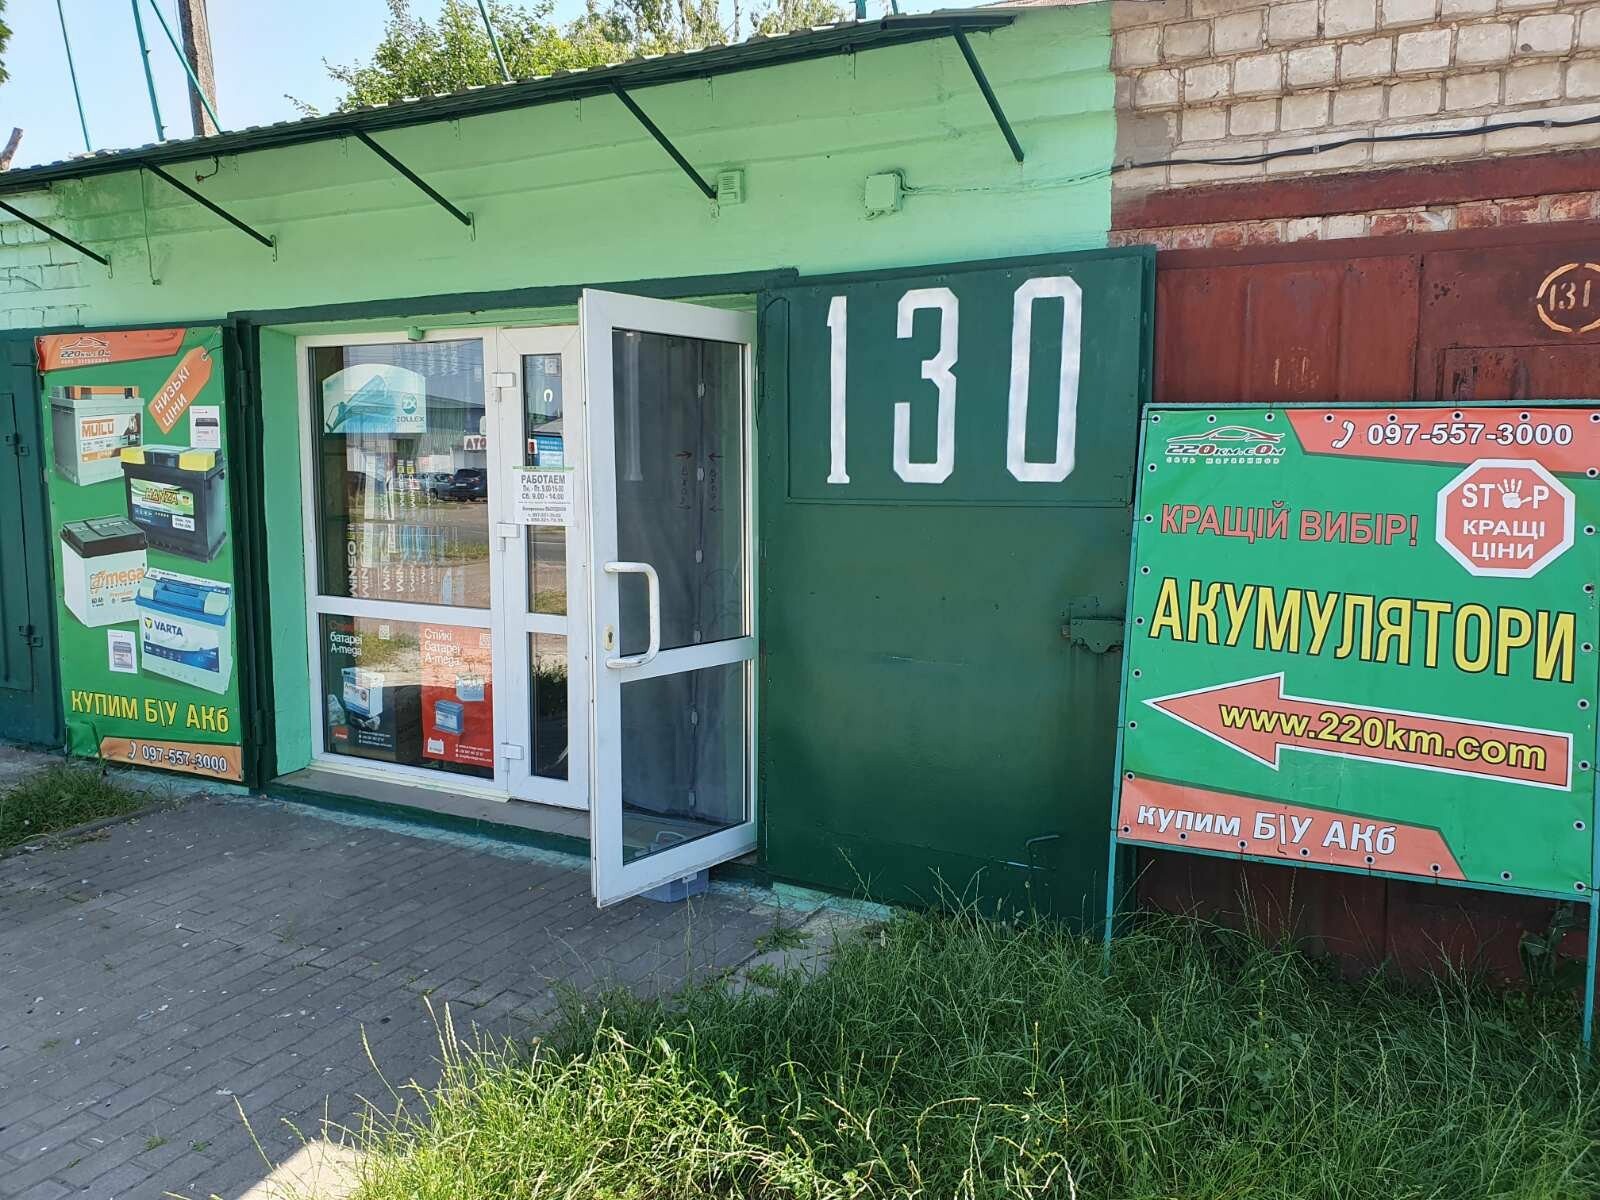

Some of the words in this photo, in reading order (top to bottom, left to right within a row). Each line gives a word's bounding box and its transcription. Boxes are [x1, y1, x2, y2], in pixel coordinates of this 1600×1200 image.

[1549, 280, 1591, 311] 131
[154, 366, 190, 413] НИЗЬКІ
[827, 276, 1082, 484] 130
[162, 392, 188, 426] ЦІНИ
[1366, 422, 1573, 446] 097-557-3000
[520, 474, 566, 484] РАБОТАЕМ
[1160, 500, 1289, 544] КРАЩІЙ
[1298, 508, 1419, 547] ВИБІР!
[1462, 519, 1546, 540] КРАЩІ
[1471, 541, 1535, 561] ЦІНИ
[153, 619, 183, 637] VARTA
[1148, 576, 1577, 684] АКУМУЛЯТОРИ
[71, 690, 139, 720] КУПИМ
[1218, 703, 1547, 771] www.220km.com
[142, 744, 228, 772] 097-557-3000
[1322, 820, 1397, 856] АКб
